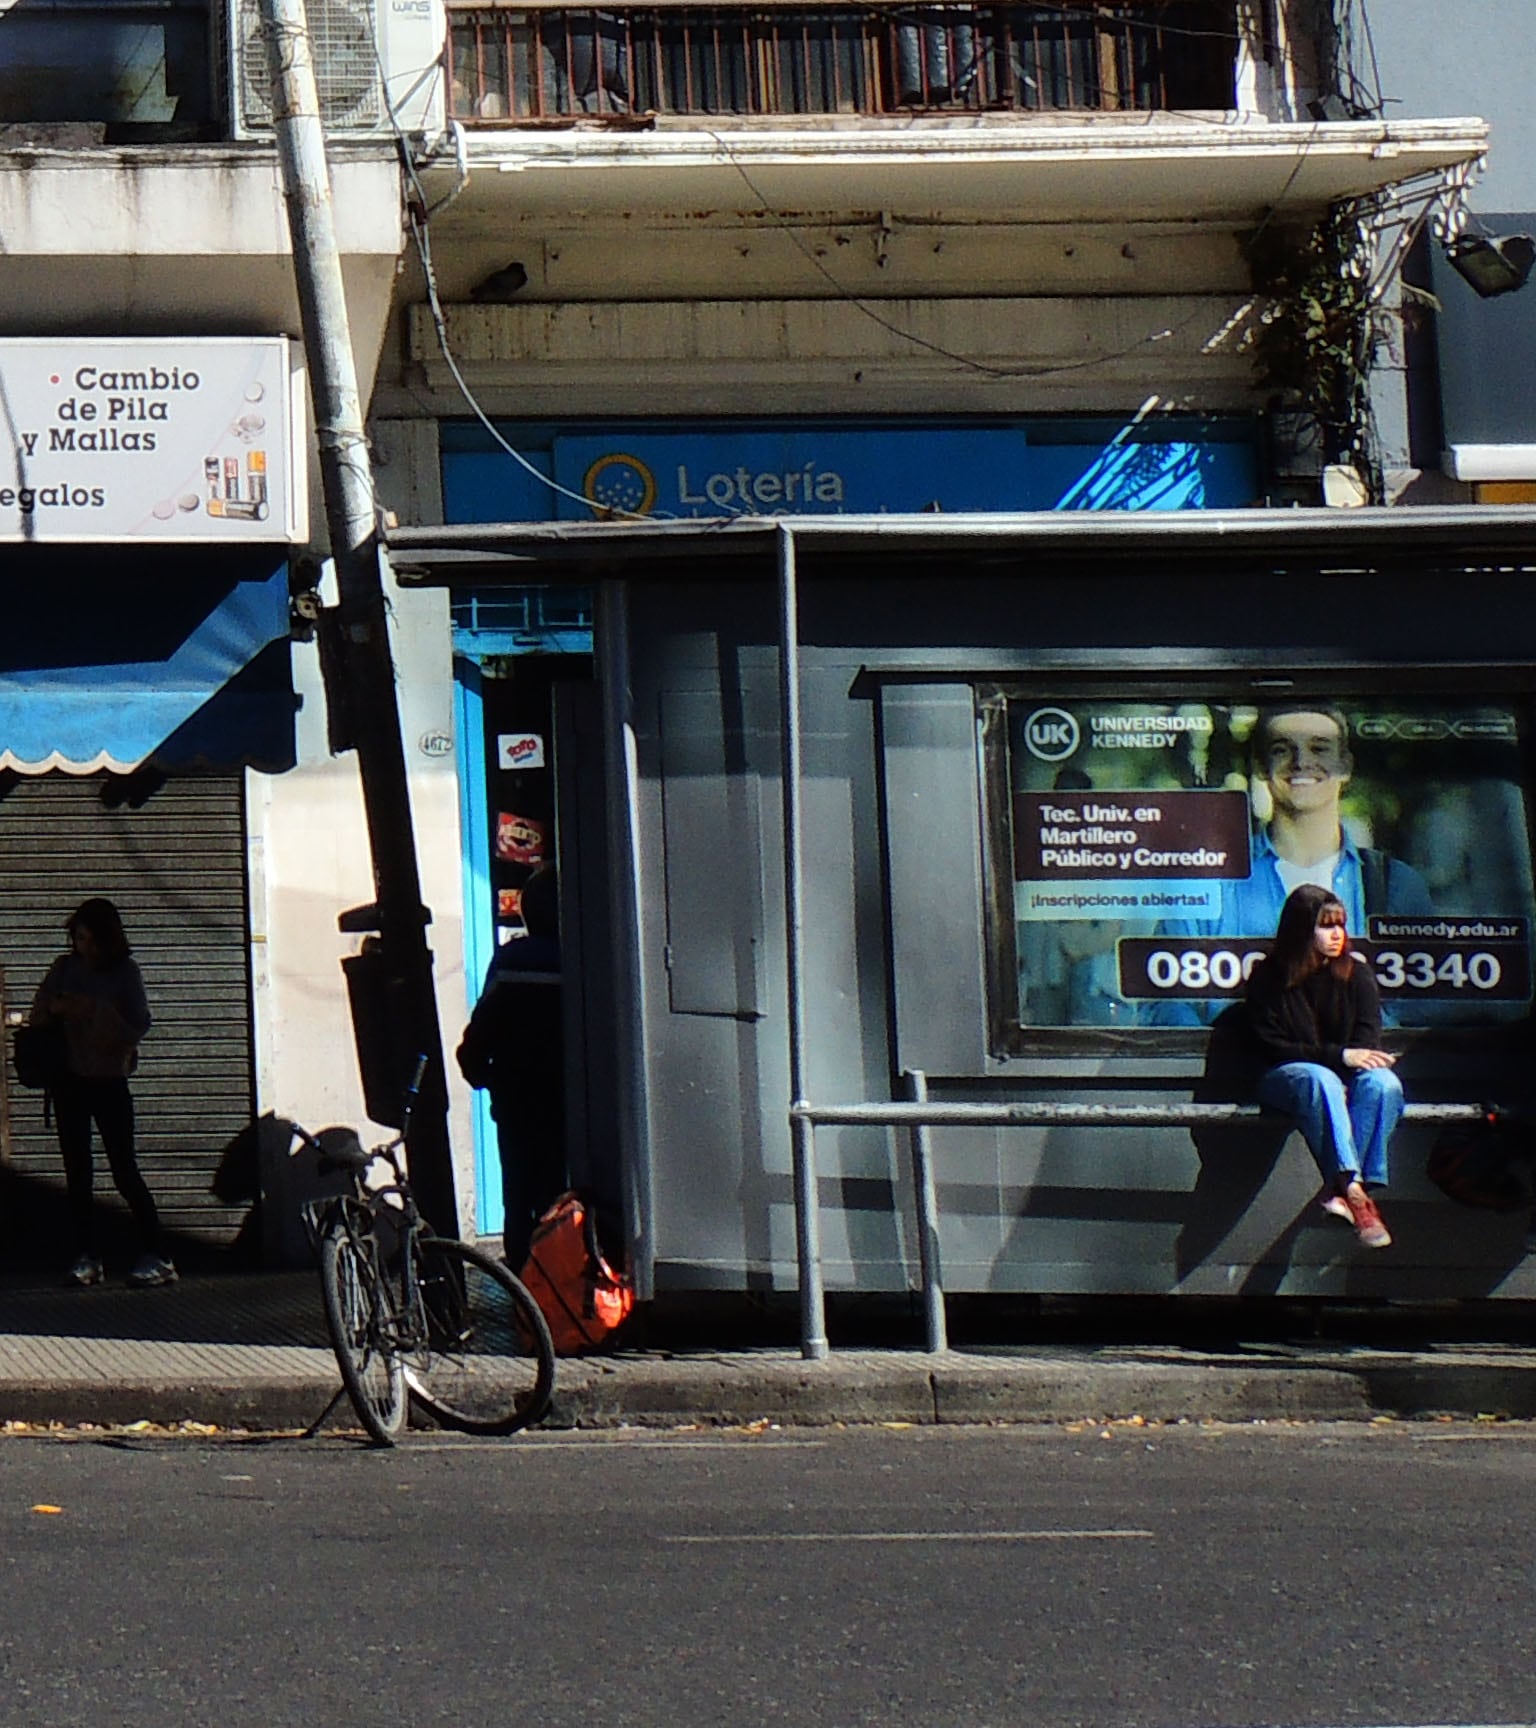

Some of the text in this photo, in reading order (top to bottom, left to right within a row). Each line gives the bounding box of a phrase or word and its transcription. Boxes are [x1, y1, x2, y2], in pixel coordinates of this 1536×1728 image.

[75, 367, 200, 391] Cambio
[57, 398, 168, 421] de Pila
[22, 429, 157, 456] y Mallas
[678, 462, 844, 504] Lotería
[1031, 723, 1070, 744] UK
[1090, 716, 1213, 732] UNIVERSIDAD
[1092, 733, 1178, 748] KENNEDY
[1039, 804, 1161, 822] Tec. Univ. en
[1040, 827, 1137, 844] Martillero
[1041, 847, 1227, 870] Público y Corredor
[1141, 892, 1210, 907] abiertas!
[1378, 921, 1519, 939] kennedy.edu.ar
[1375, 951, 1501, 990] 3340
